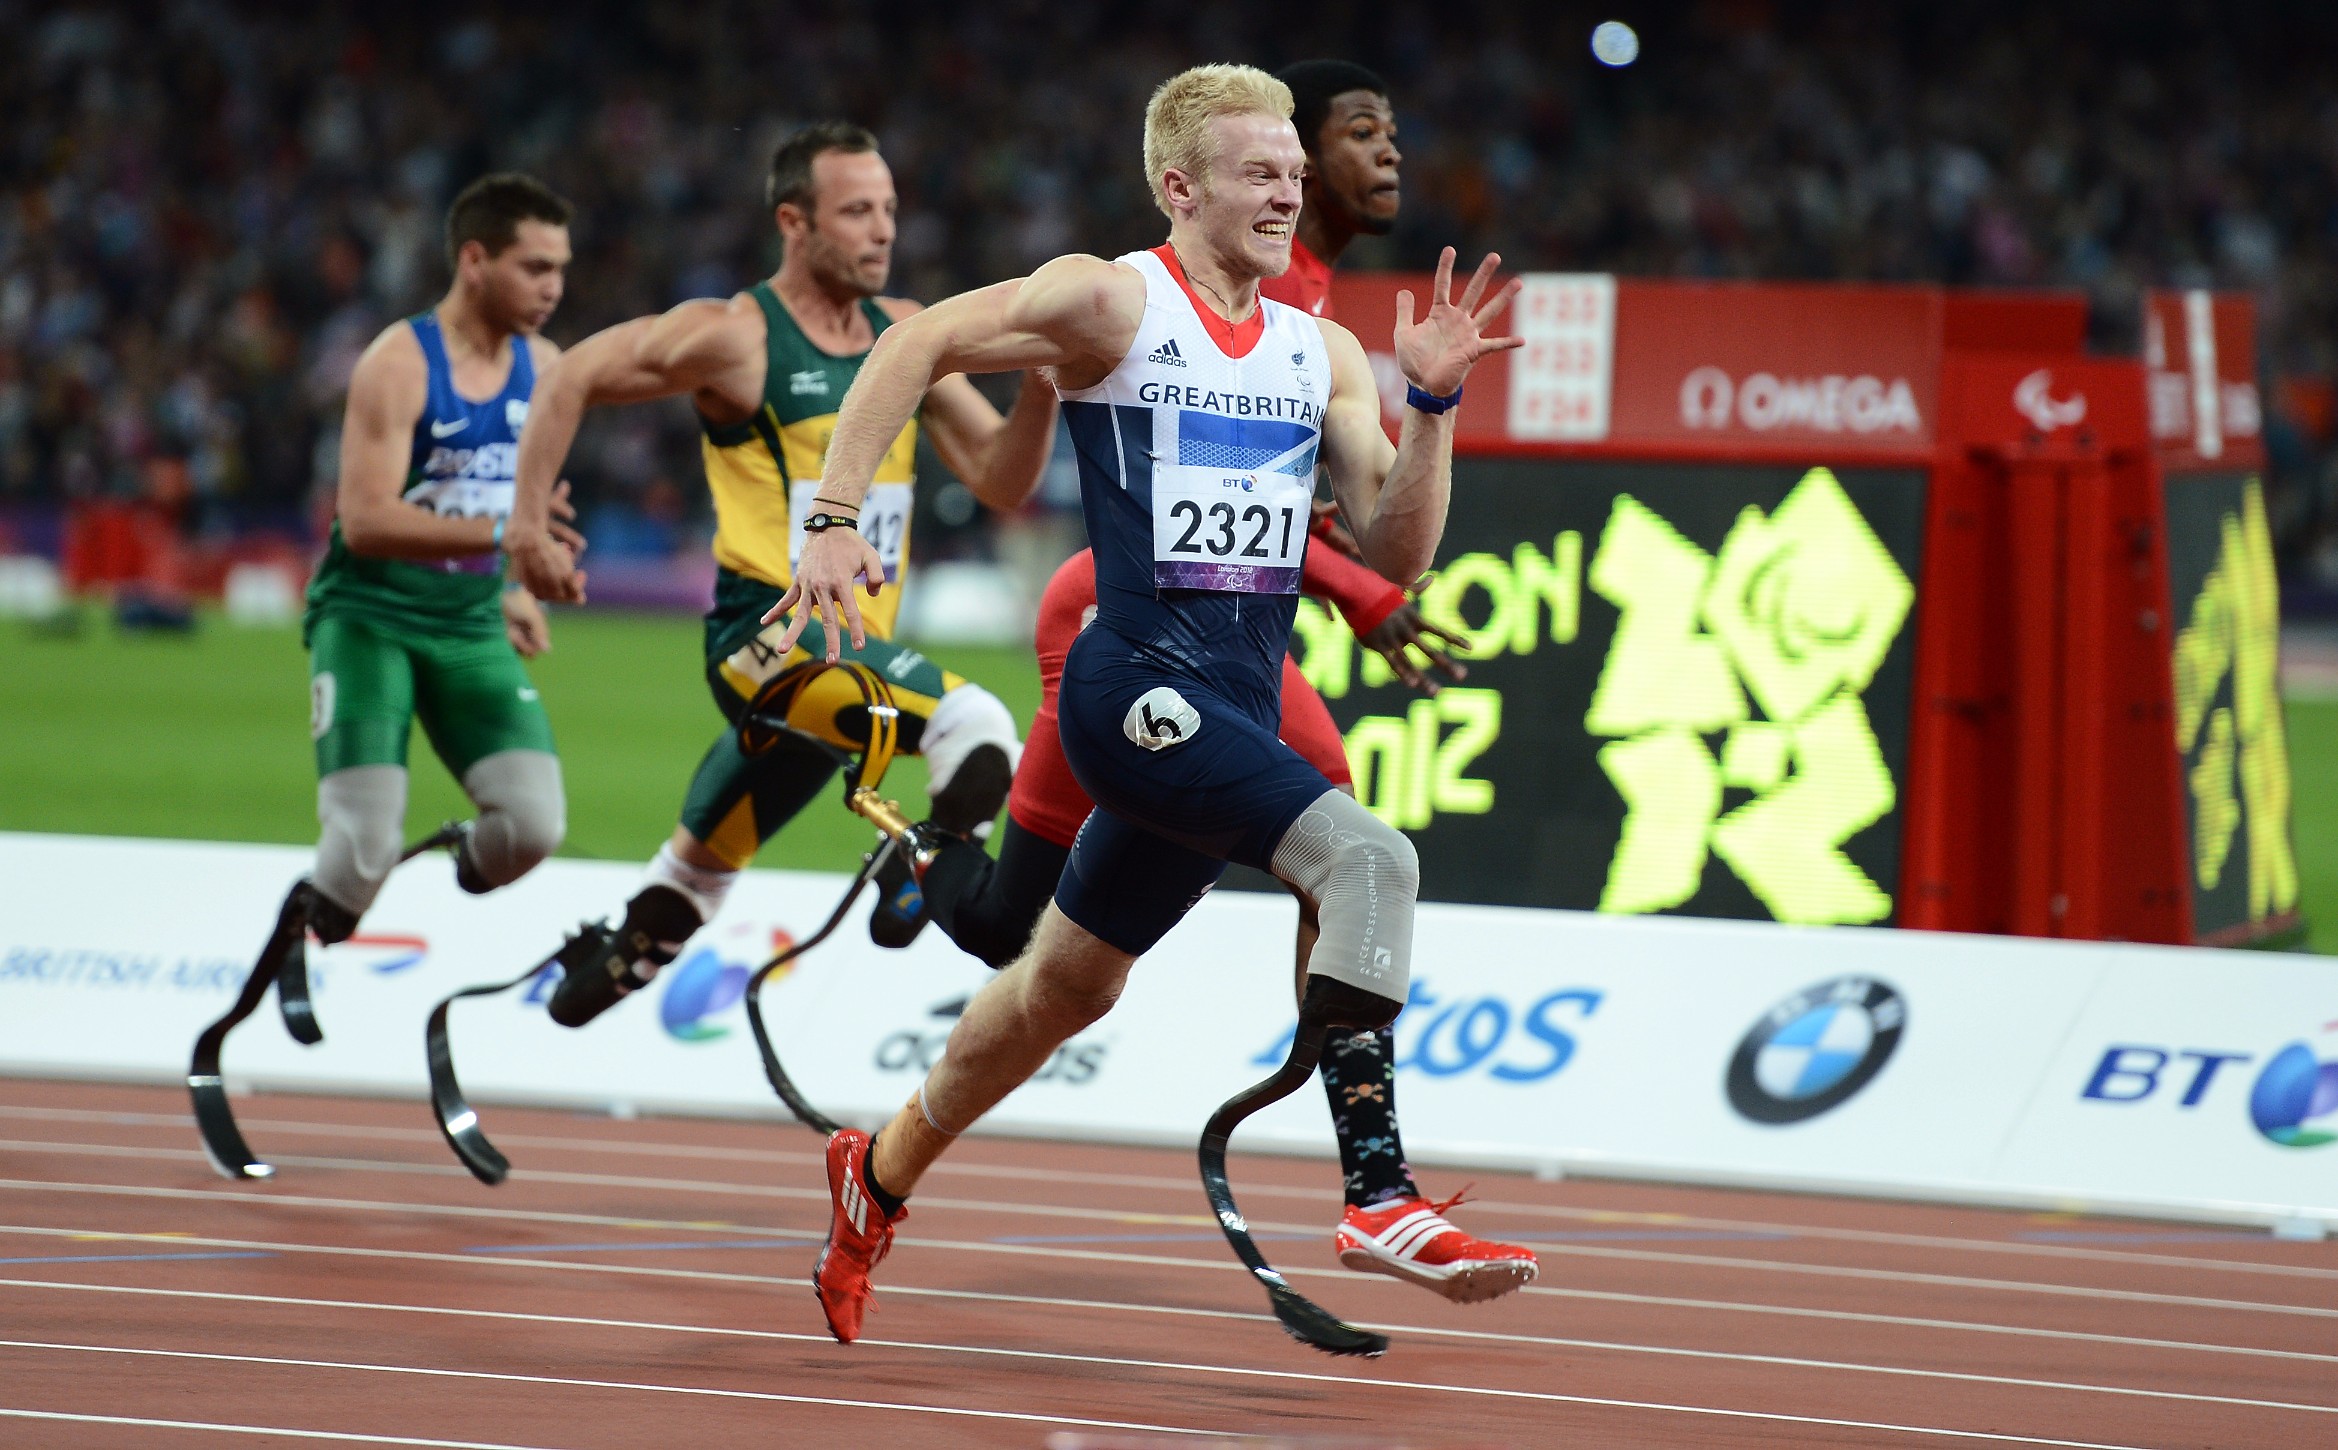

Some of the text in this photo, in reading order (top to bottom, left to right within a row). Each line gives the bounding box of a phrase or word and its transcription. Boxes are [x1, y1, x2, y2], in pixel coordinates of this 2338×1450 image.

[1148, 353, 1187, 368] adidas
[1739, 373, 1922, 433] OMEGA
[1223, 478, 1240, 488] BT
[862, 512, 902, 555] 42
[1169, 500, 1294, 559] 2321
[1142, 701, 1182, 739] 6
[1342, 687, 1502, 830] 012
[1, 946, 155, 988] BRITISH
[2080, 1046, 2253, 1108] BT
